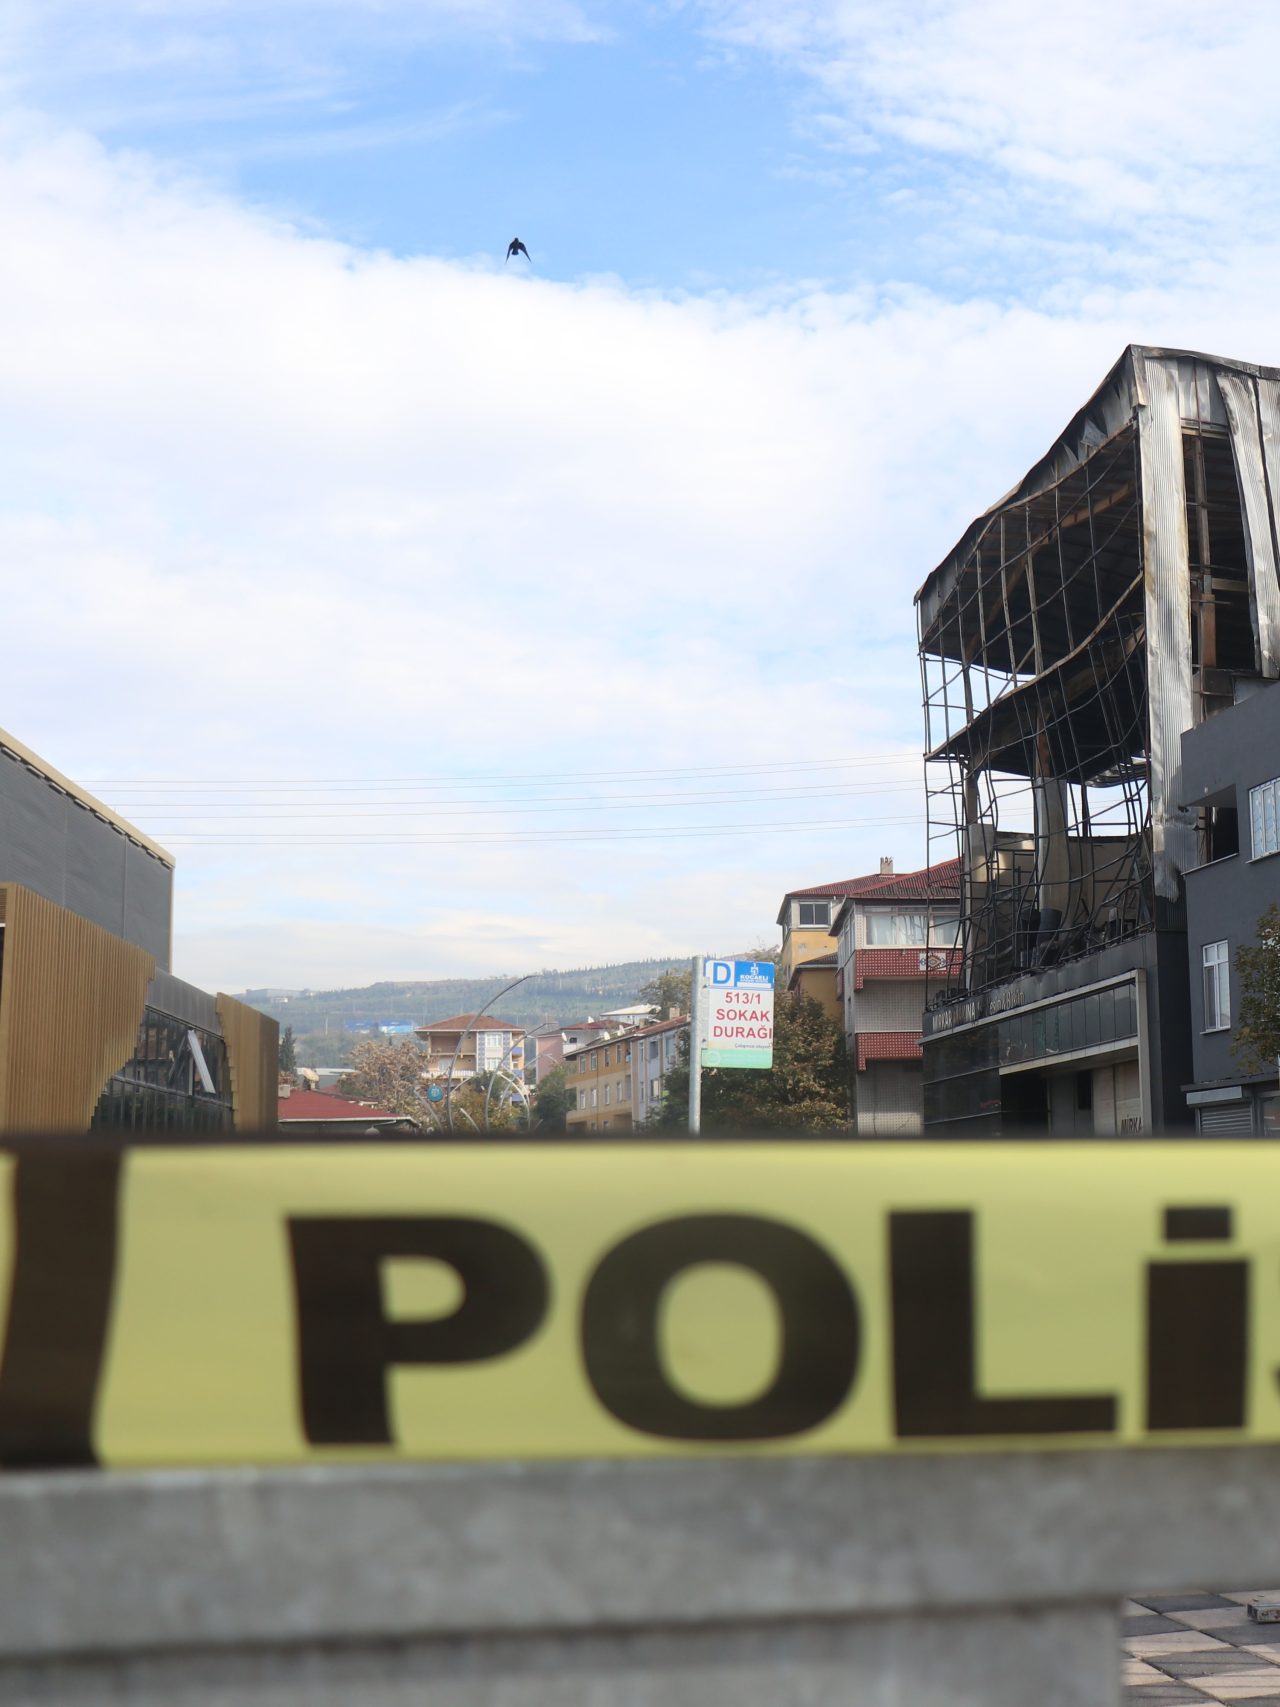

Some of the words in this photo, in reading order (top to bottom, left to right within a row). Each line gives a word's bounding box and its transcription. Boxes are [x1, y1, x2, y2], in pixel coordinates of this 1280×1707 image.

[713, 962, 732, 985] D
[725, 992, 761, 1005] 513/1
[716, 1008, 770, 1022] SOKAK
[713, 1024, 772, 1040] DURAĞI
